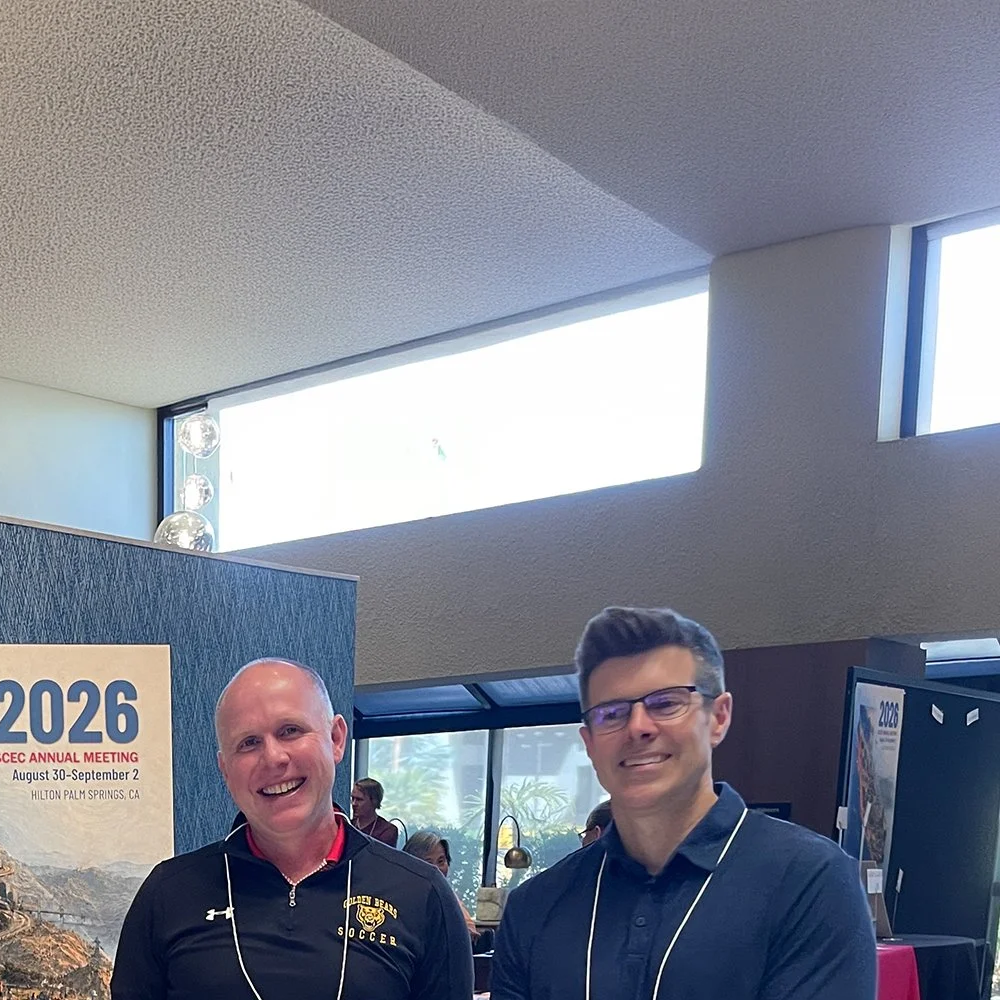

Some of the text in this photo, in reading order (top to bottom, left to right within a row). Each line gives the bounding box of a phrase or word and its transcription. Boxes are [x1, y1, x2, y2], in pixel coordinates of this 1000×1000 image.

[879, 700, 899, 728] 2026
[29, 752, 80, 763] ANNUAL
[83, 752, 138, 763] MEETING
[12, 769, 49, 783] August
[132, 768, 139, 780] 2
[31, 789, 140, 801] HILTON PALM SPRINGS, CA
[374, 898, 397, 919] BEARS
[337, 926, 397, 946] SOCCER
